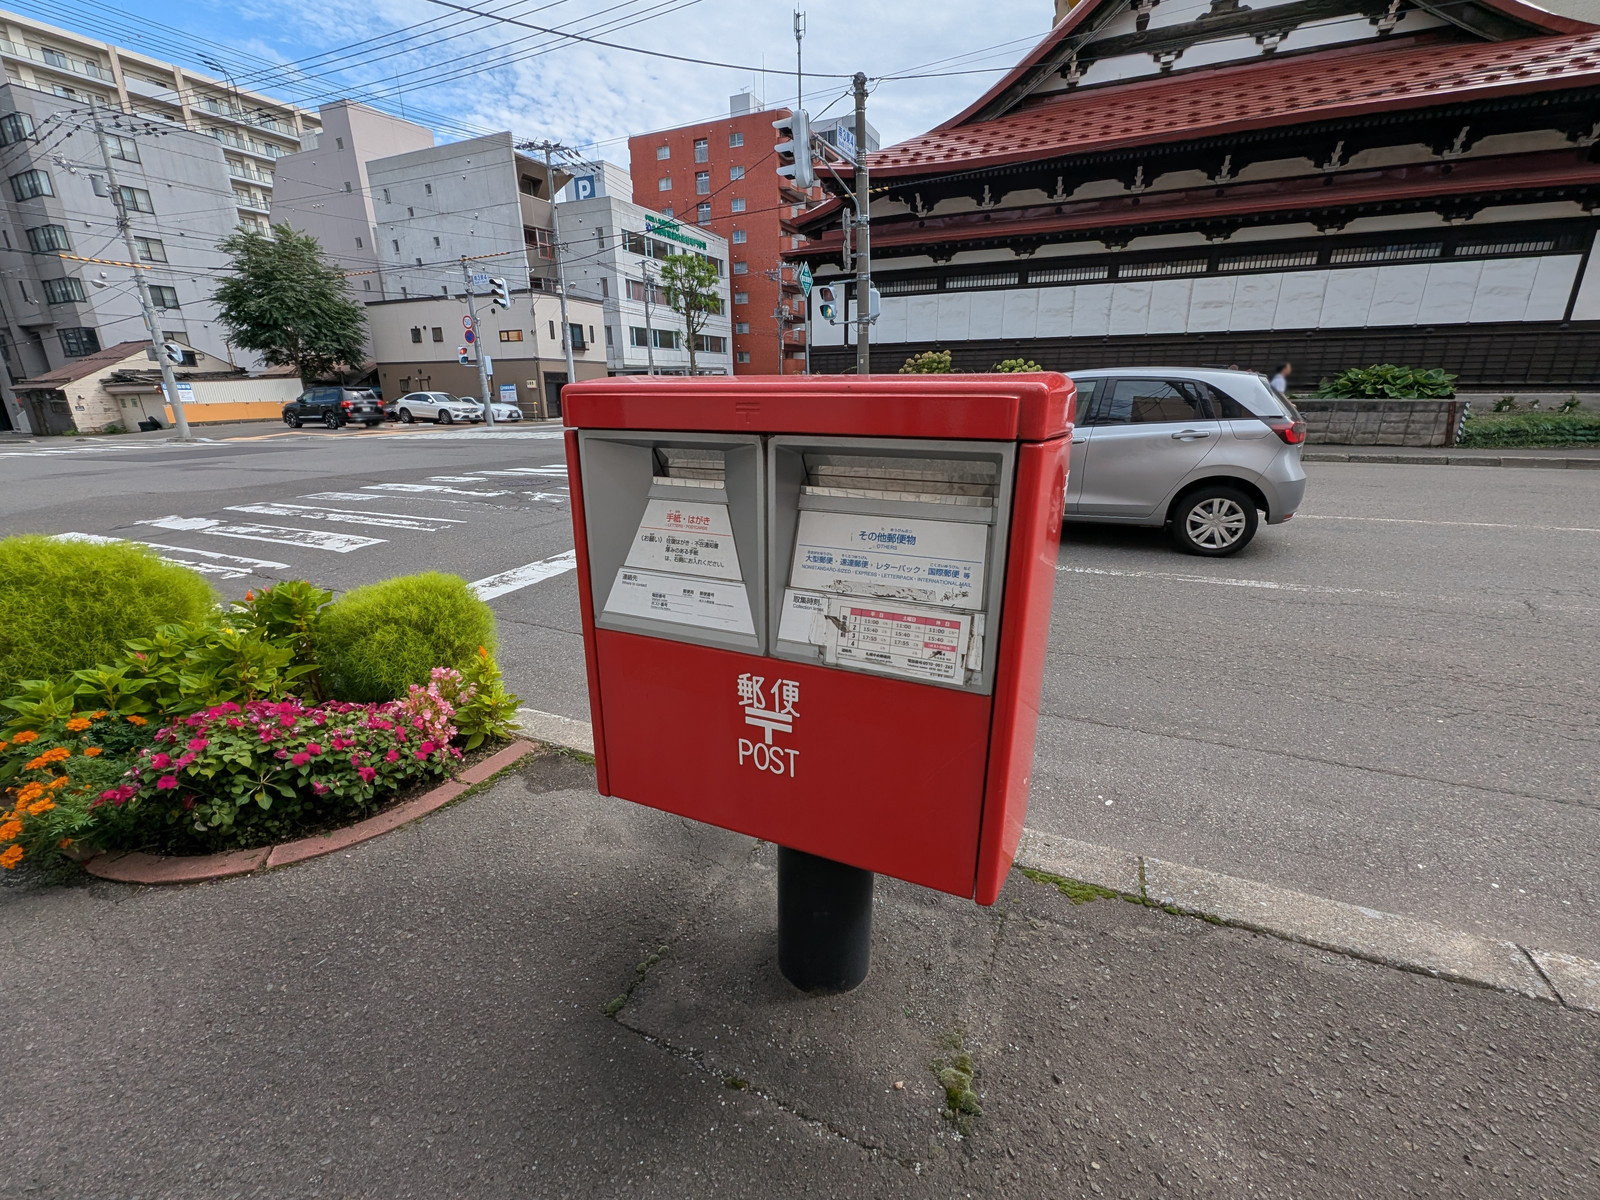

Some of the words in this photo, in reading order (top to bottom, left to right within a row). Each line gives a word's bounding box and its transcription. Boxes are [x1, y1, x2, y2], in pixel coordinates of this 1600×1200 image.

[578, 180, 591, 200] P
[666, 512, 710, 526] 手紙・はがき
[859, 530, 917, 546] その他郵便物
[876, 543, 898, 551] OTHERS
[854, 569, 878, 578] EXPRESS
[881, 573, 914, 582] LETTERPACK
[737, 672, 800, 718] 郵便
[738, 738, 800, 778] POST
